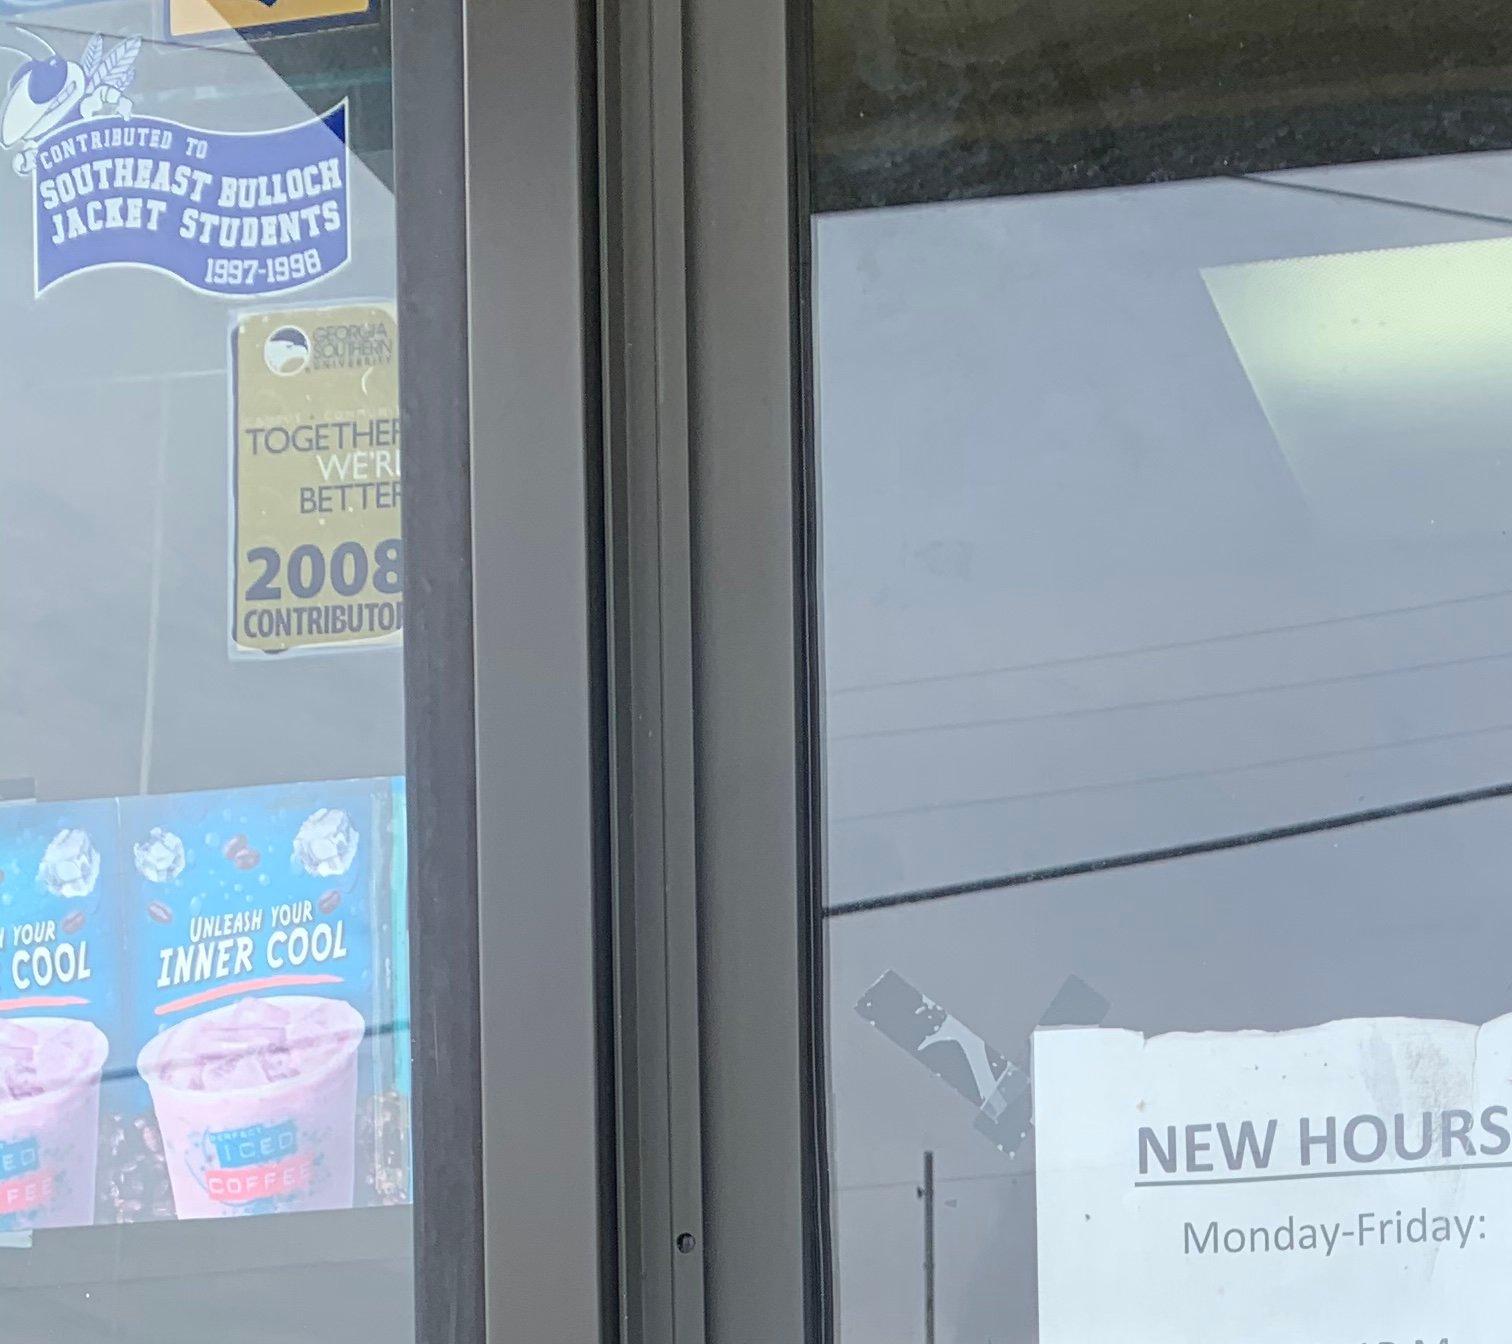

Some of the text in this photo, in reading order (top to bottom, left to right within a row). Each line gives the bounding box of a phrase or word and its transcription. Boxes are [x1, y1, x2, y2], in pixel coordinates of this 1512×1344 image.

[40, 127, 209, 170] CONTRIBUTED TO
[39, 157, 343, 210] SOUTHEAST BULLOCH
[51, 197, 341, 248] JACKET STUDENTS
[204, 248, 322, 285] 1997-1998
[314, 323, 387, 341] GEORGIA
[314, 340, 391, 358] SOUTHERN
[245, 538, 404, 601] 2008
[13, 920, 56, 946] YOUR
[190, 900, 313, 942] UNLEASH YOUR
[12, 942, 91, 989] COOL
[156, 920, 347, 988] INNER COOL
[224, 1132, 294, 1162] ICED
[1137, 1117, 1279, 1176] NEW
[209, 1165, 313, 1194] COFFEE
[1184, 1206, 1487, 1257] Monday-Friday:
